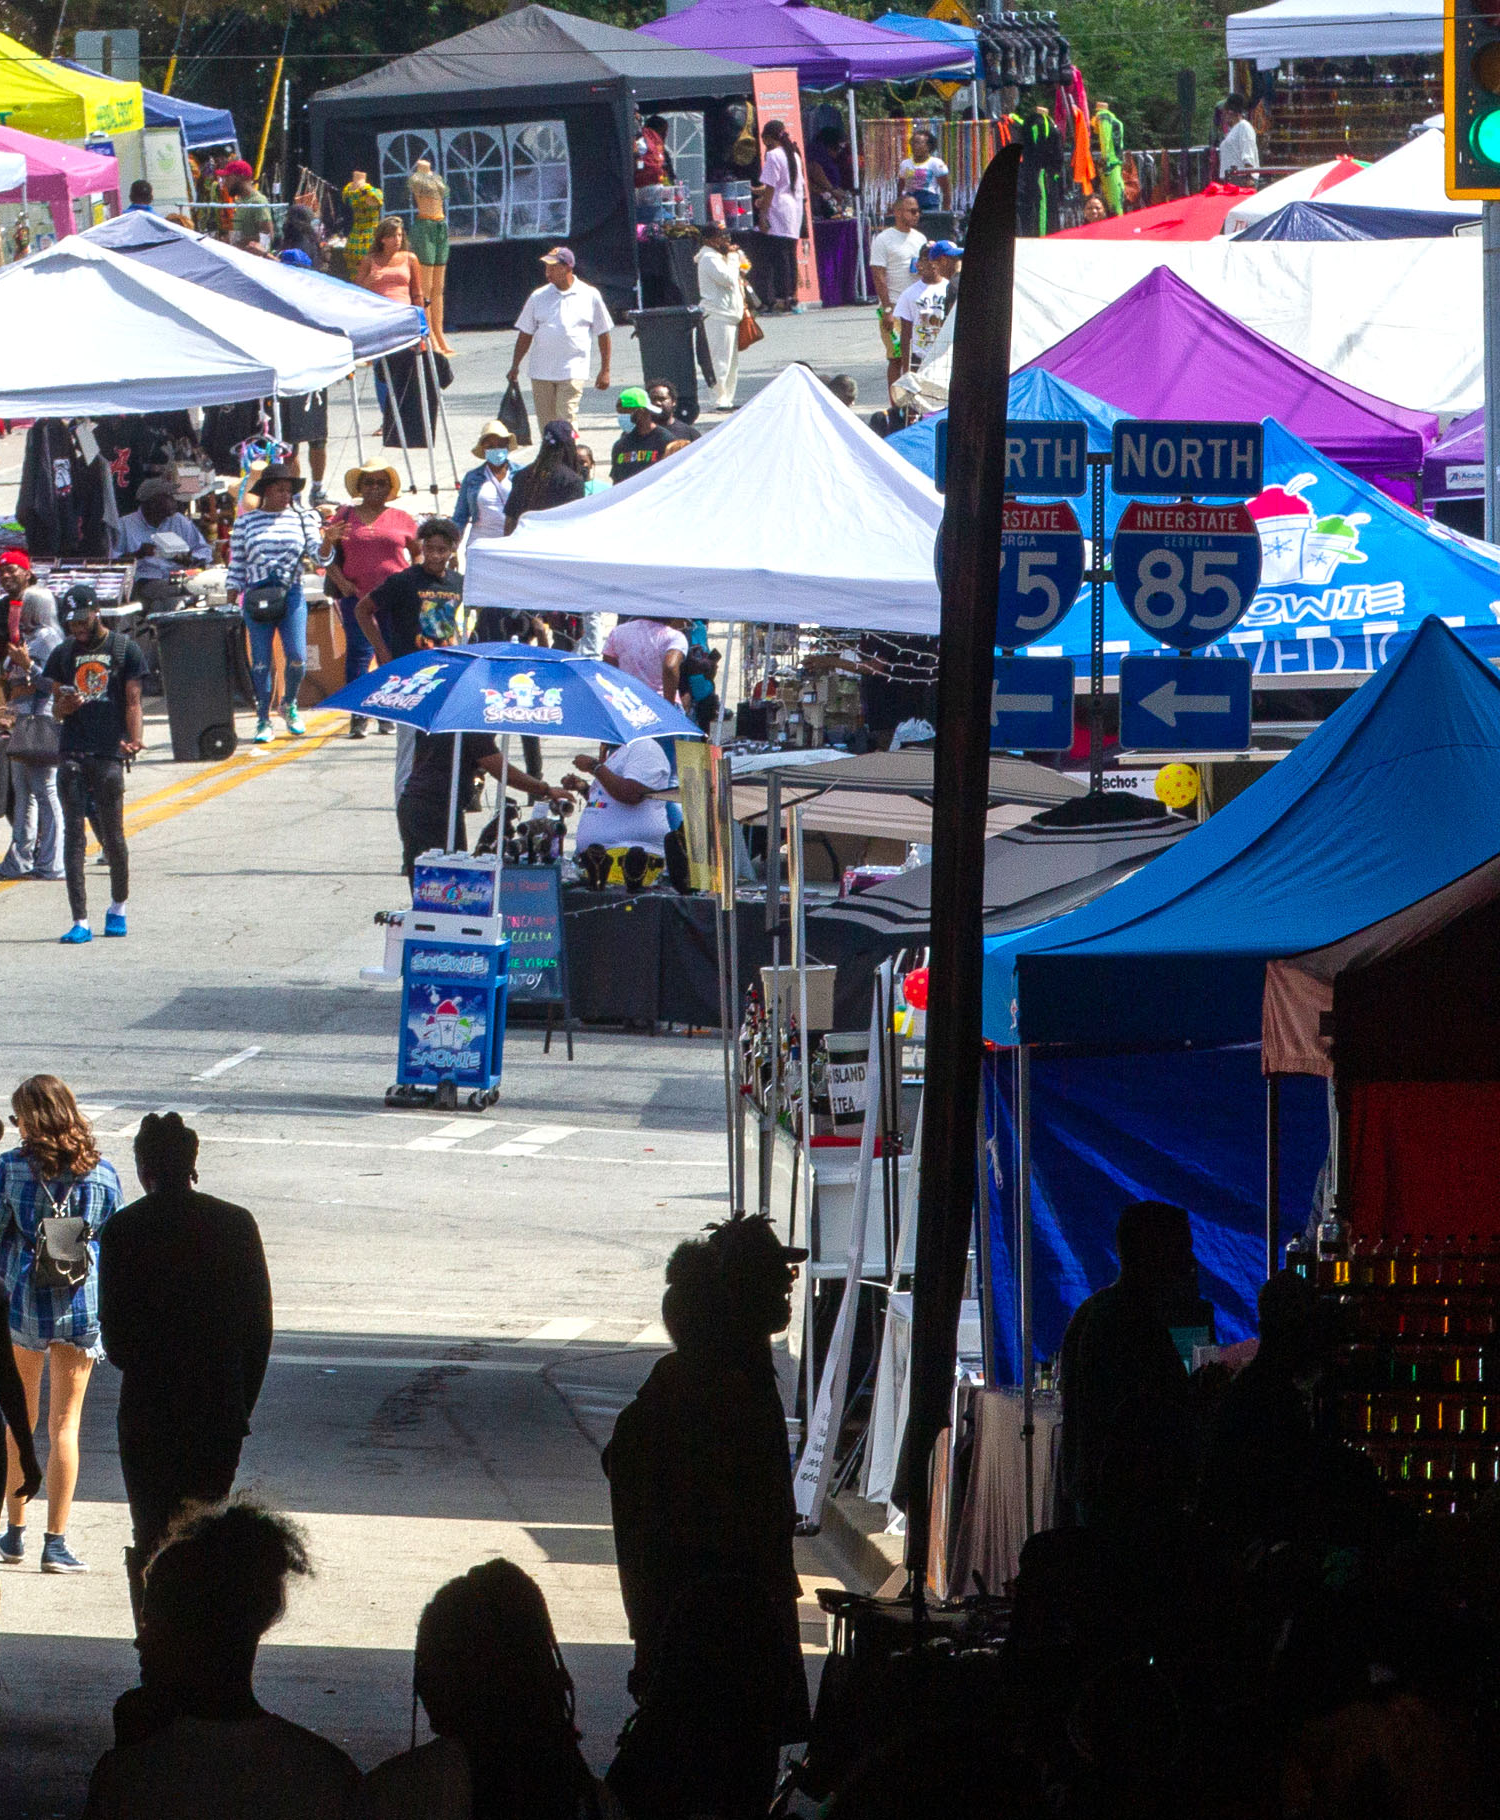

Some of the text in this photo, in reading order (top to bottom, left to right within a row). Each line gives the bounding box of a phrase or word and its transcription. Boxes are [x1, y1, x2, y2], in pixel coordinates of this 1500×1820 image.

[1004, 438, 1077, 478] RTH
[1121, 434, 1255, 479] NORTH
[1002, 510, 1060, 529] RSTATE
[1137, 510, 1238, 530] INTERSTATE
[1001, 536, 1037, 548] ORGIA
[1164, 536, 1213, 548] GEORGIA
[1001, 551, 1060, 631] 5
[1134, 549, 1242, 630] 85
[1239, 581, 1406, 626] OWIE
[483, 705, 564, 725] SNOWIE
[1102, 774, 1138, 789] achos
[411, 952, 487, 974] SNOWIE
[508, 972, 543, 991] NJOY
[410, 1048, 482, 1070] SNOWIE
[832, 1066, 866, 1084] ISLAND
